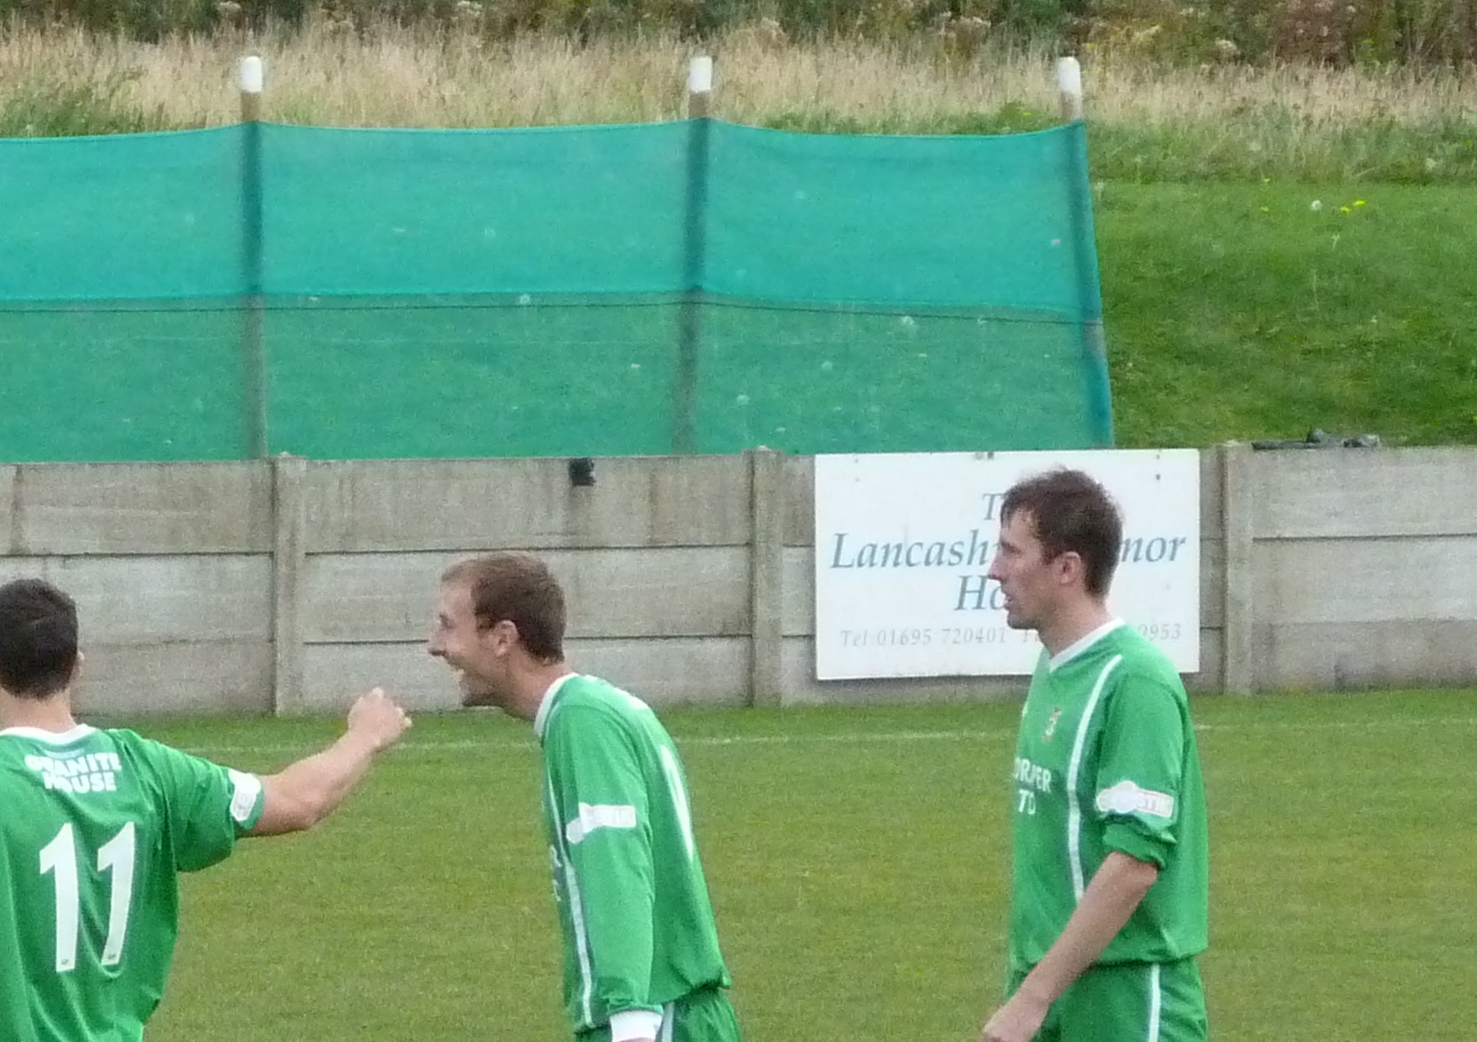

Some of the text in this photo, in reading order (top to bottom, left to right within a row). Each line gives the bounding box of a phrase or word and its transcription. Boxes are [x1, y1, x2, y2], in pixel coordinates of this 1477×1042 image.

[830, 528, 1187, 569] Lancash nor
[954, 575, 1005, 612] Ho
[24, 752, 122, 777] GRANITE
[42, 771, 117, 794] HOUSE
[39, 821, 135, 972] 11
